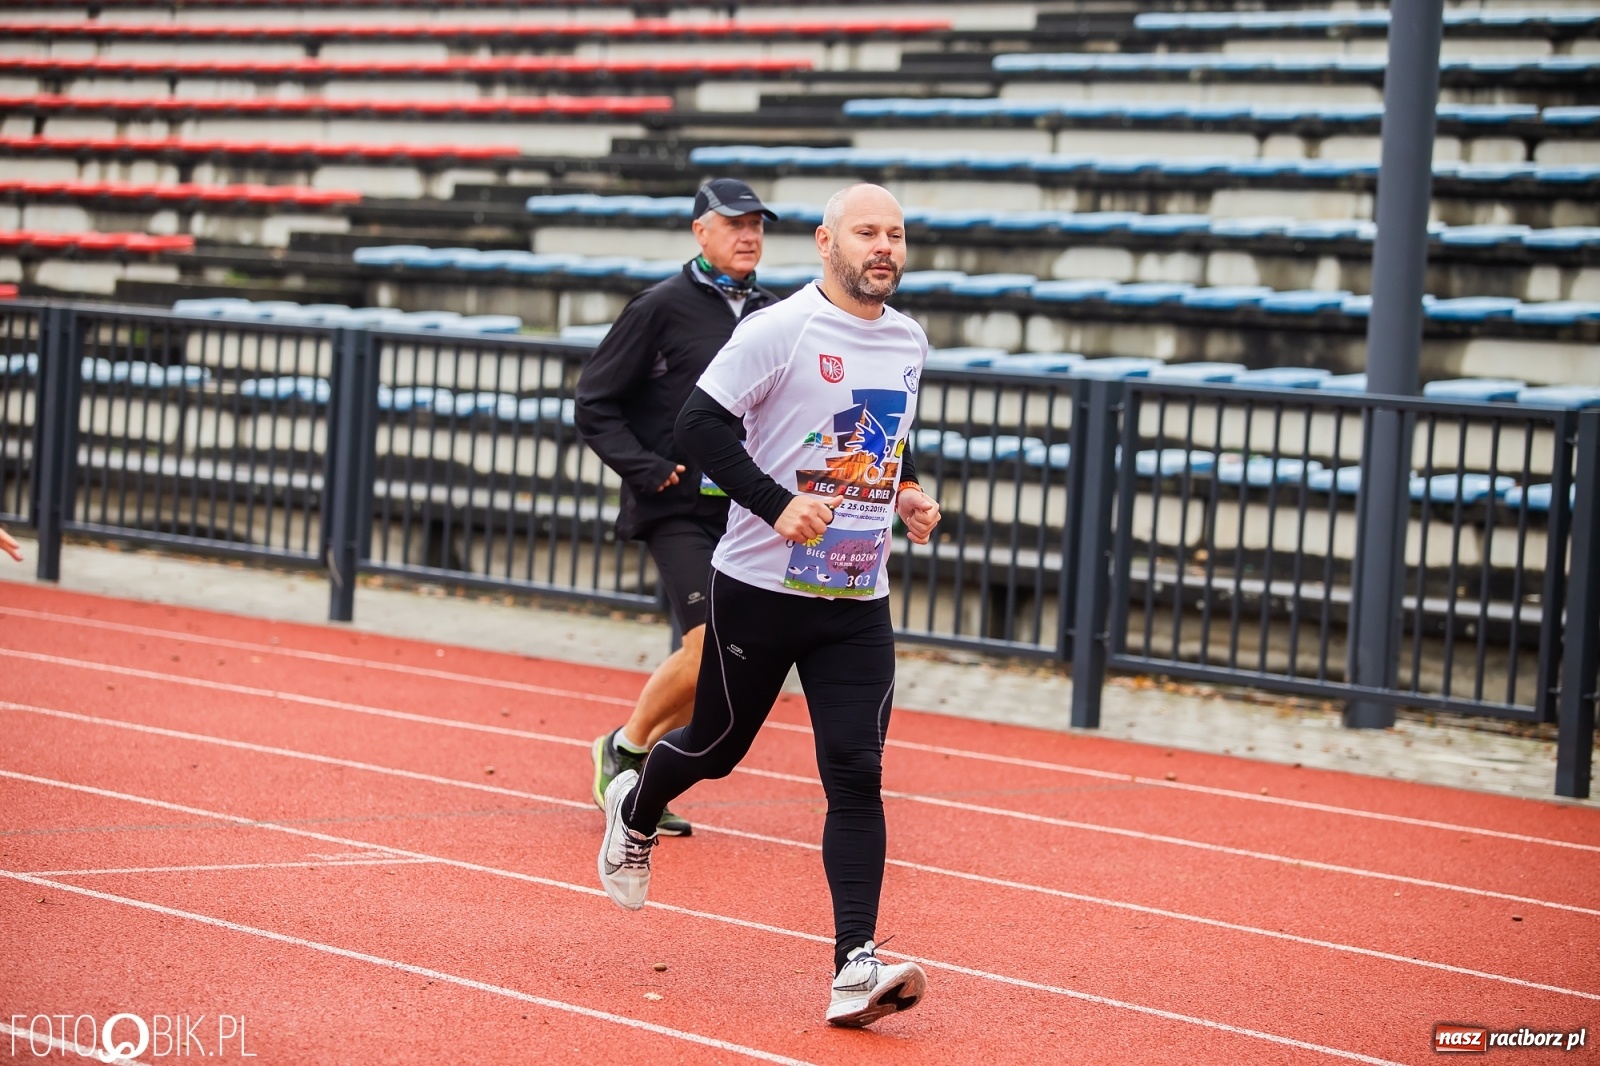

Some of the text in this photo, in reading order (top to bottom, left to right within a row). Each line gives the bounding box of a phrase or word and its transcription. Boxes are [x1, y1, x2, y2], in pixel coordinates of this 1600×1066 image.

[806, 480, 835, 494] BIEG
[837, 484, 860, 497] BEZ
[806, 548, 826, 558] BIEG
[830, 552, 846, 561] DLA
[845, 574, 871, 587] 303
